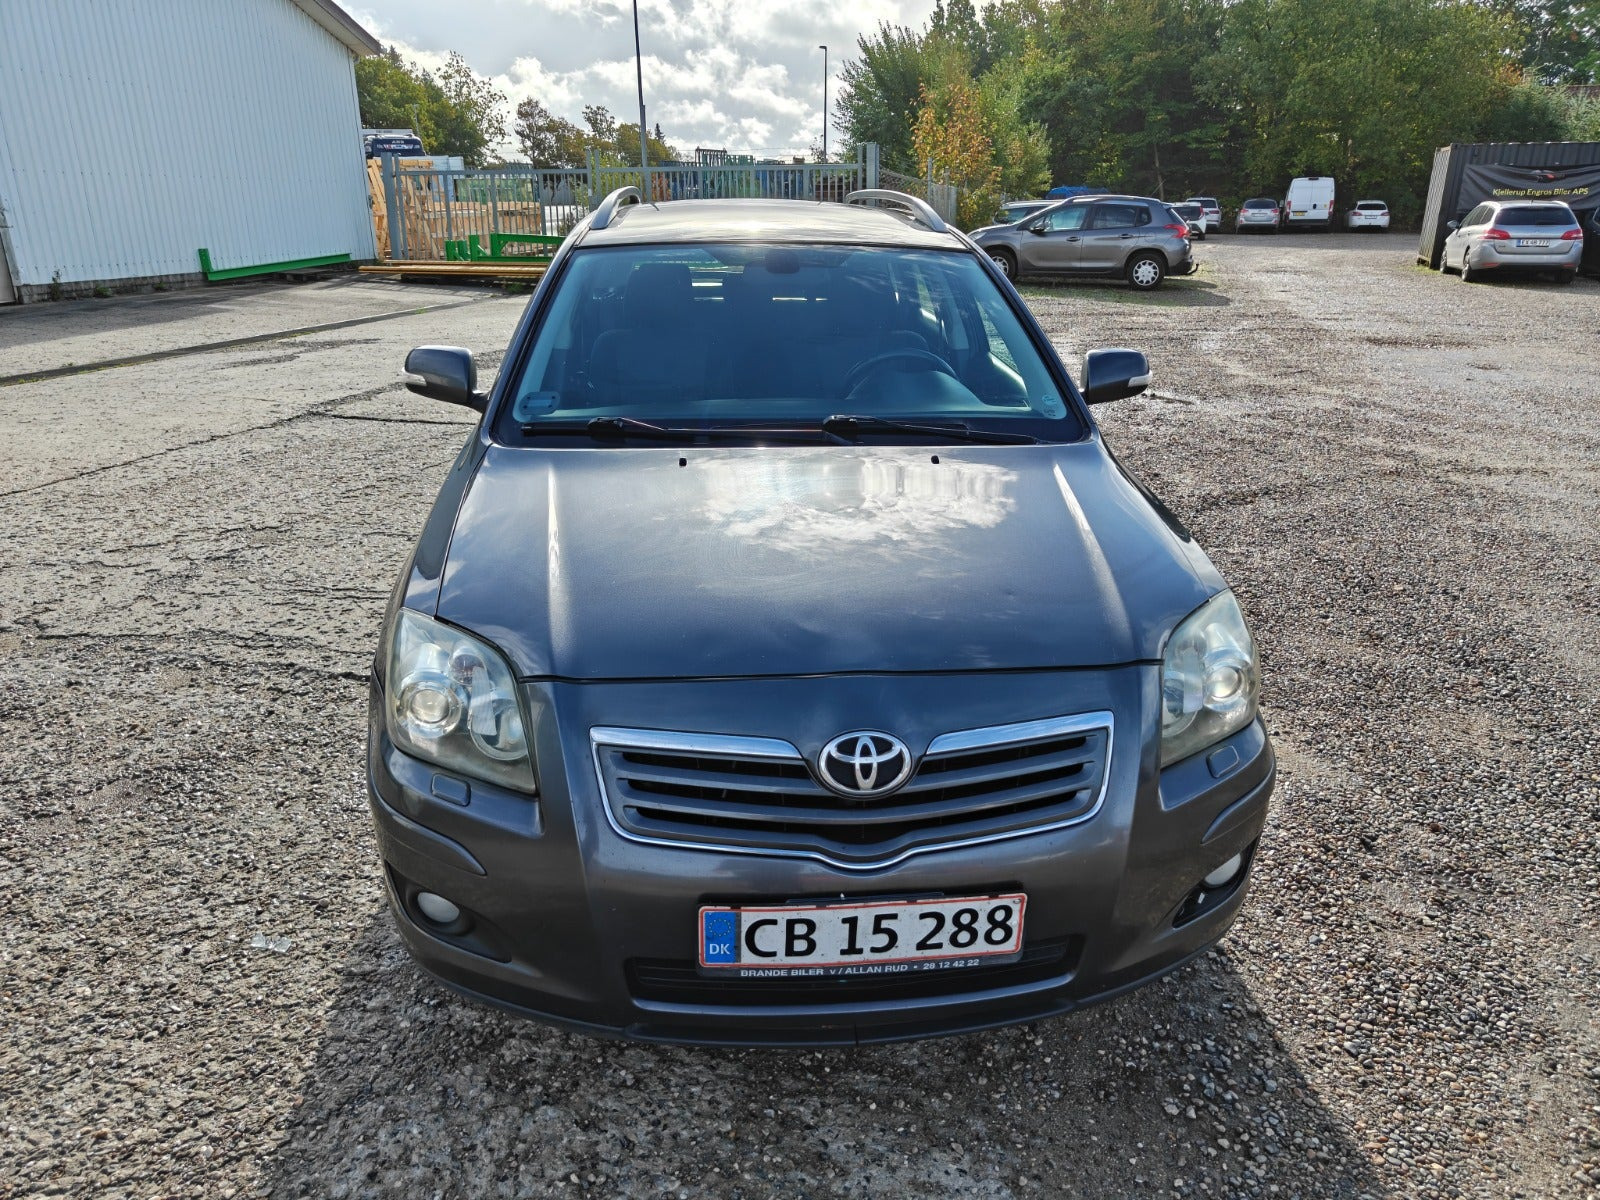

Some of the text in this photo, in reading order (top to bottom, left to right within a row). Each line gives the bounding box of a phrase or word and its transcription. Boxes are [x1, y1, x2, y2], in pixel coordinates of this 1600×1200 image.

[1492, 188, 1526, 197] Kjellerup
[1527, 188, 1552, 197] Engros
[744, 904, 1014, 958] CB 15 288
[708, 943, 731, 955] DK
[740, 969, 788, 977] BRANDE
[790, 968, 824, 976] BILER
[844, 965, 882, 975] ALLAN
[884, 964, 908, 973] RUD
[922, 962, 936, 970] 28
[939, 961, 950, 969] 12
[952, 960, 965, 968] 42
[966, 958, 980, 967] 22
